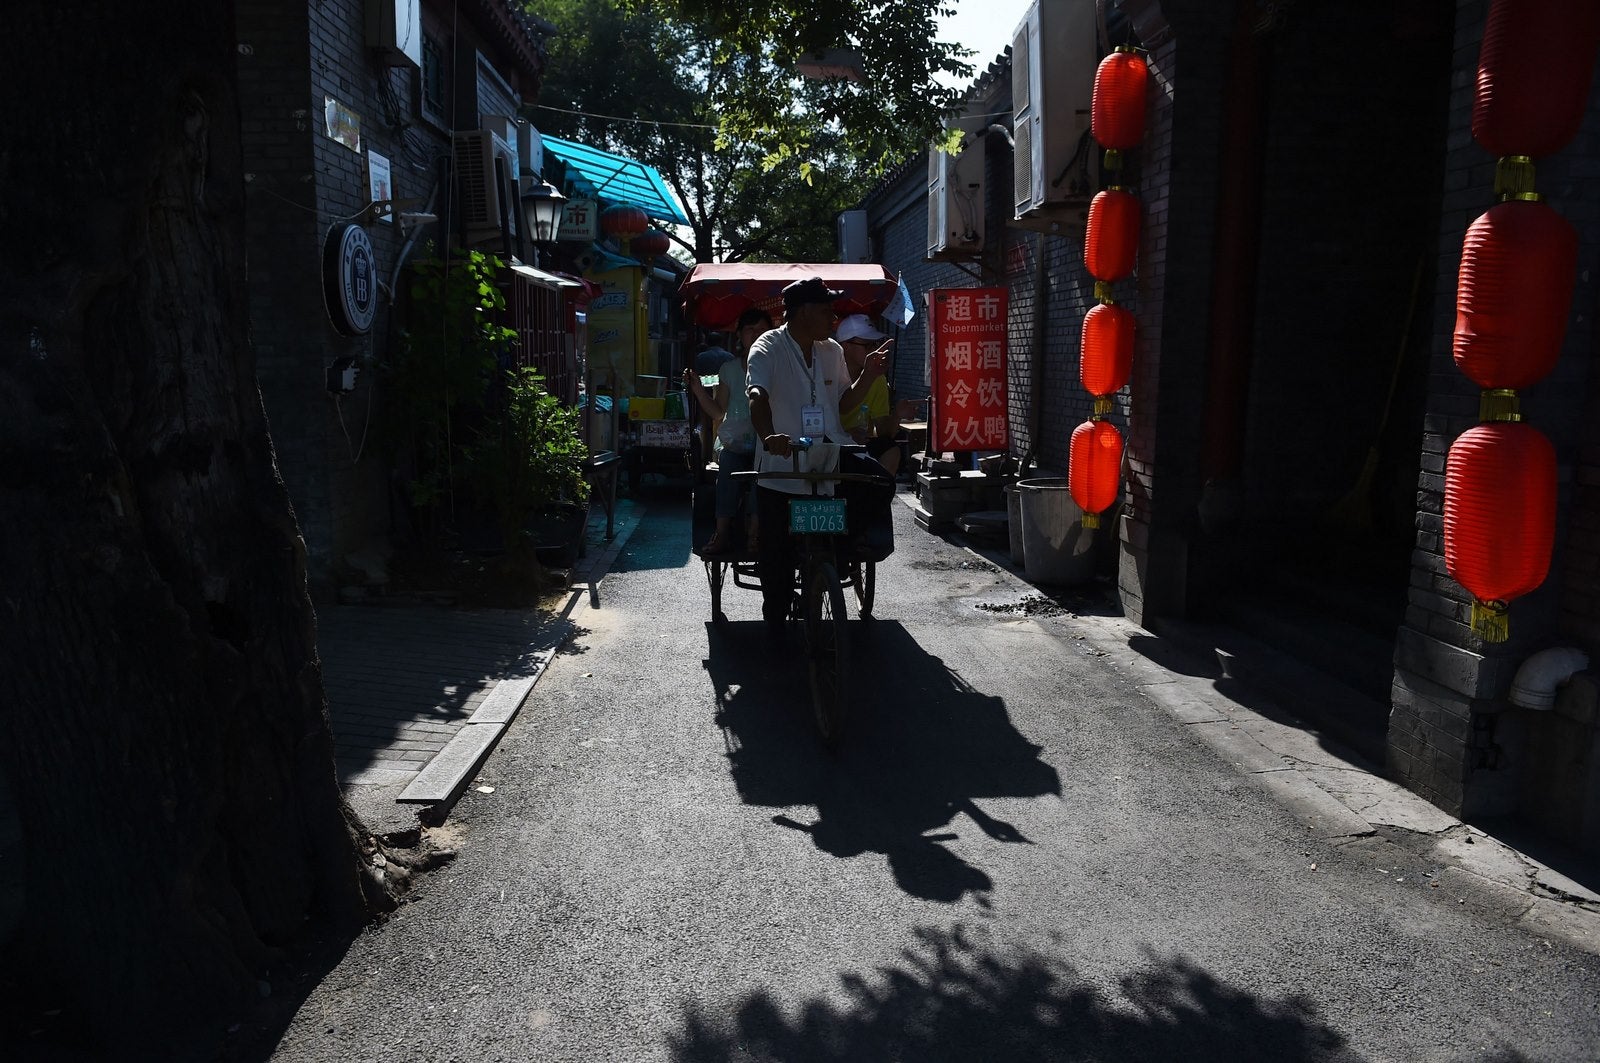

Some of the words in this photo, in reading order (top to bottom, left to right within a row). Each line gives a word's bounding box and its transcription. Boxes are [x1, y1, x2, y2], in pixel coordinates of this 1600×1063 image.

[946, 293, 1000, 321] 超市
[942, 323, 1004, 334] Supermarket
[944, 340, 1001, 370] 烟酒
[944, 377, 1002, 408] 冷饮
[943, 414, 1006, 446] 久久鸭
[811, 515, 844, 531] 0263
